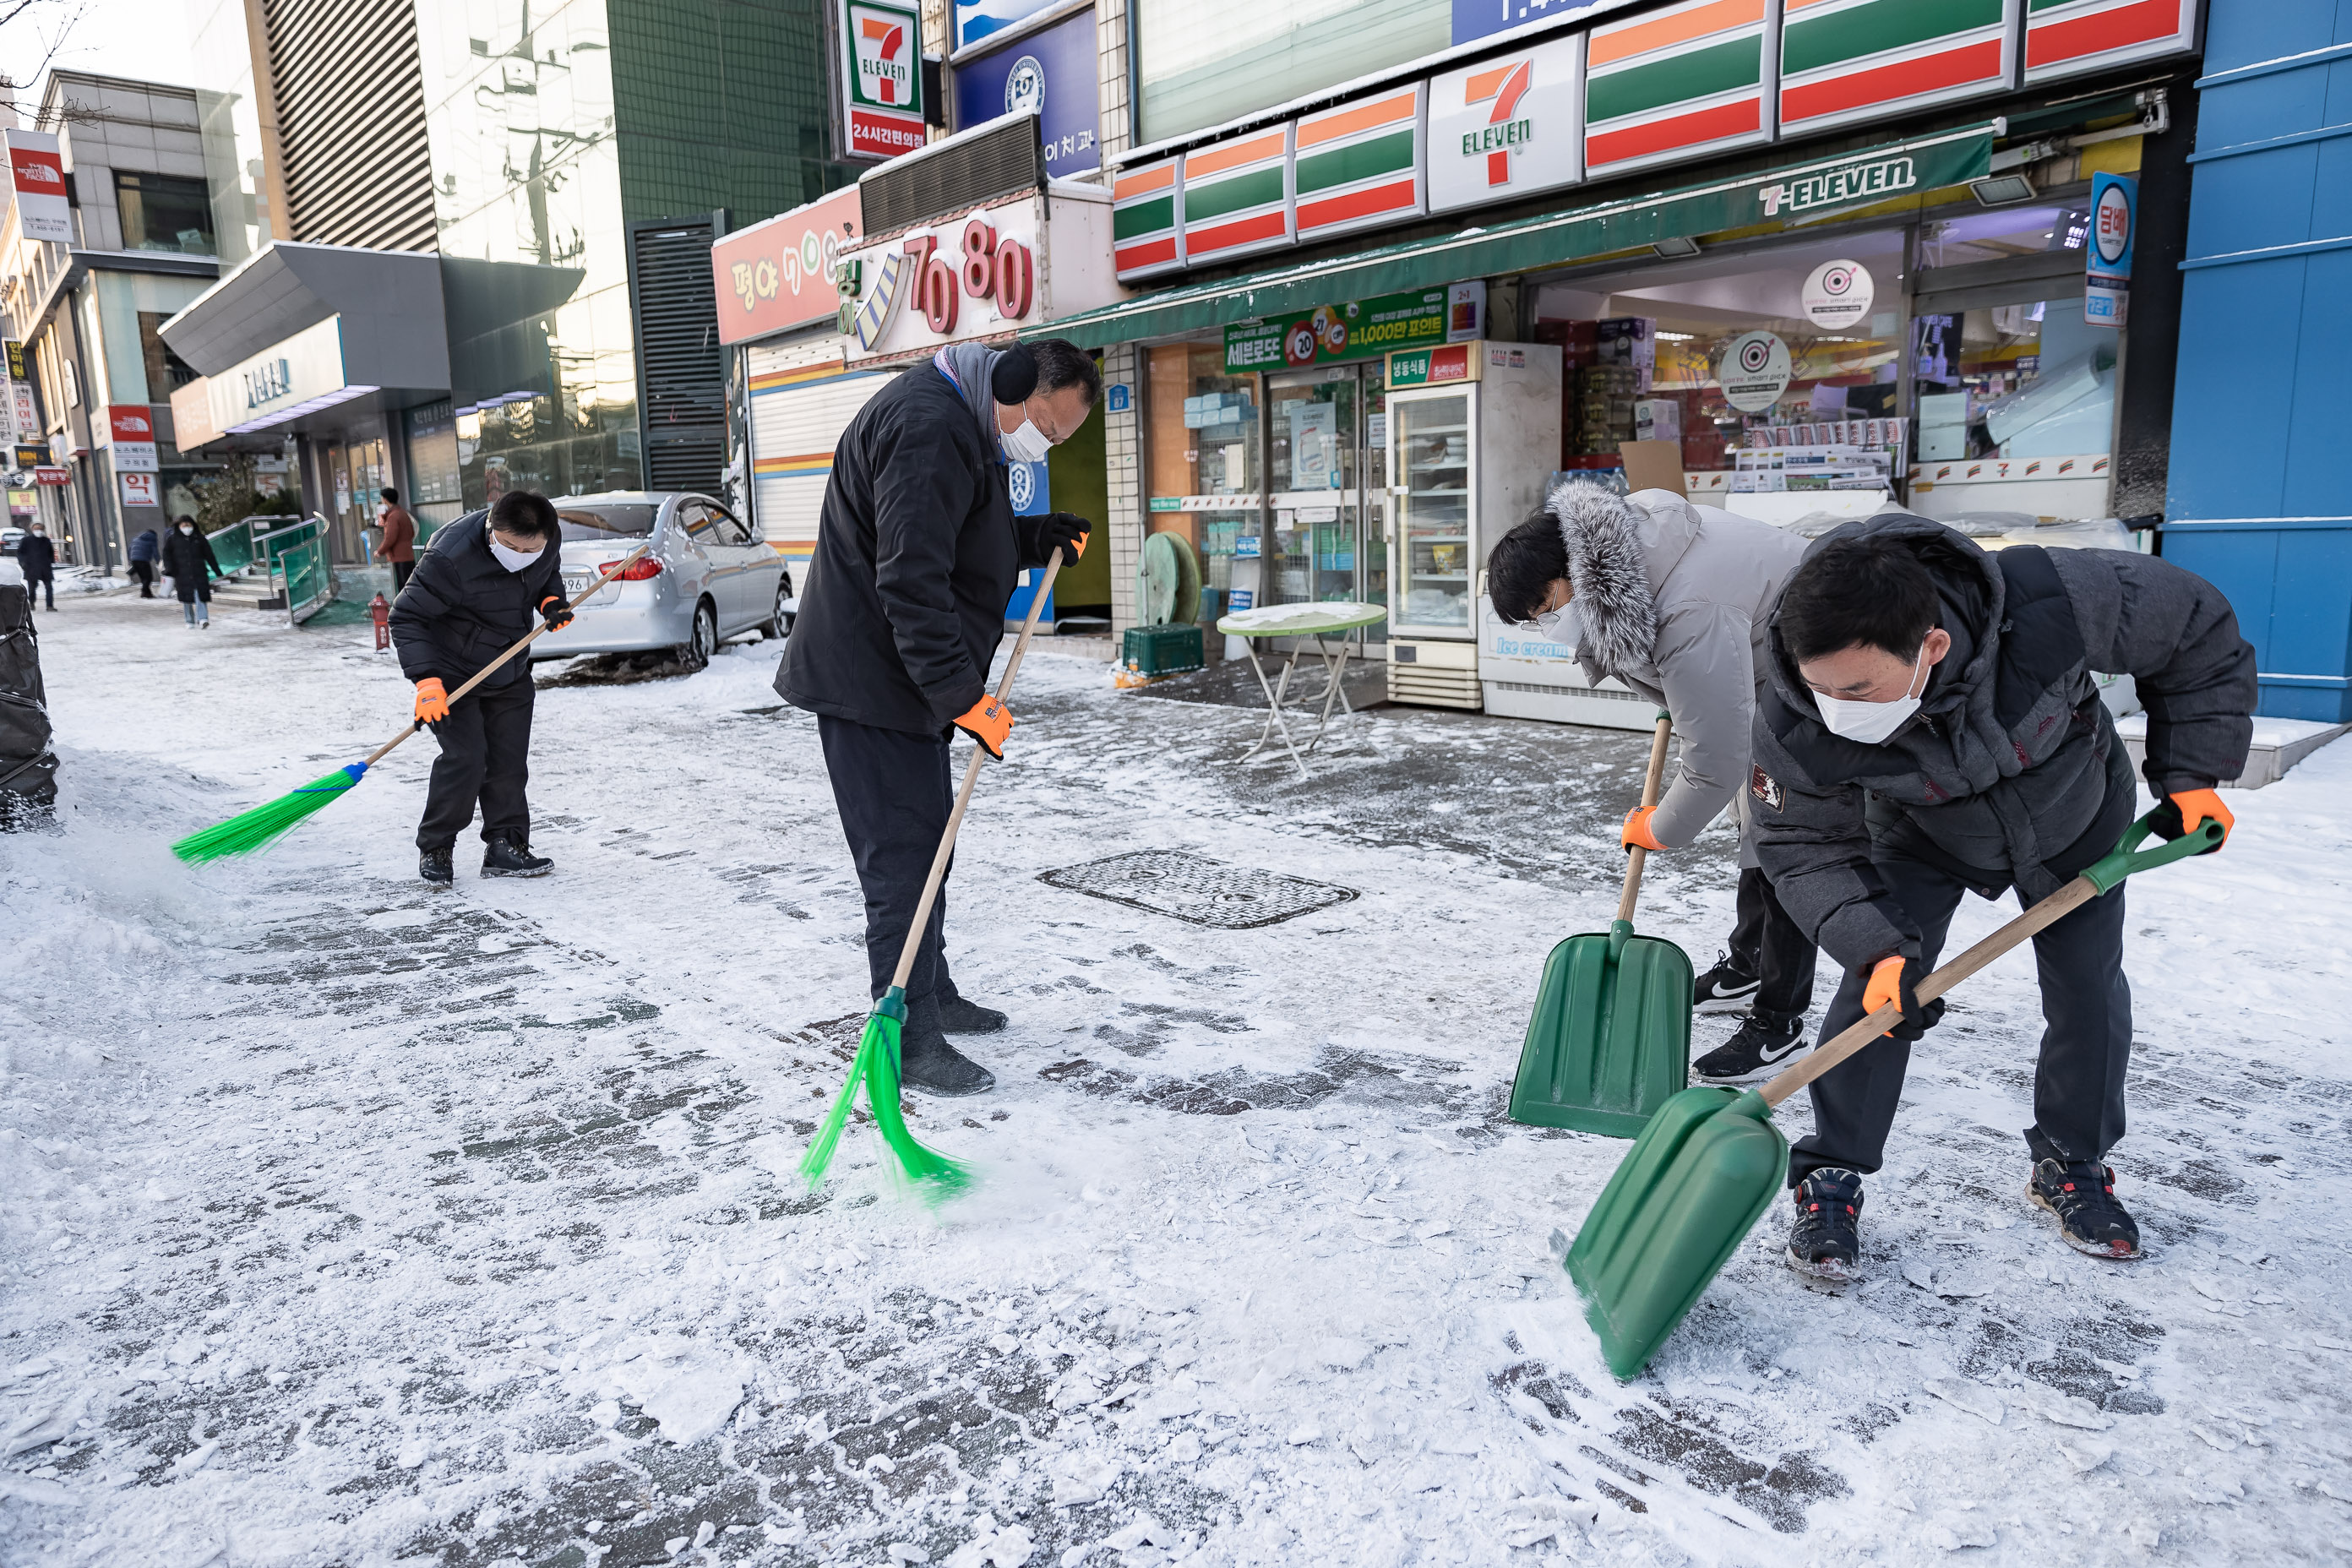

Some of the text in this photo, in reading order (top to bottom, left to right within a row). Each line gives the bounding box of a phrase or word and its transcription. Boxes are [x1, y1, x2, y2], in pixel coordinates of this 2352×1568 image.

[862, 18, 903, 104] 7
[853, 123, 923, 149] 24시간편의점
[1465, 60, 1530, 186] 7
[18, 167, 45, 177] NORTH
[2100, 205, 2126, 237] 담배
[903, 218, 1032, 334] 7080
[1360, 321, 1407, 345] 1,000만
[1408, 316, 1441, 336] 포인트
[1228, 338, 1280, 366] 세븐로또
[1298, 335, 1311, 353] 20
[1394, 359, 1426, 377] 냉동식품
[1113, 397, 1124, 408] 87
[126, 475, 150, 494] 약
[1497, 637, 1568, 657] Ice cream
